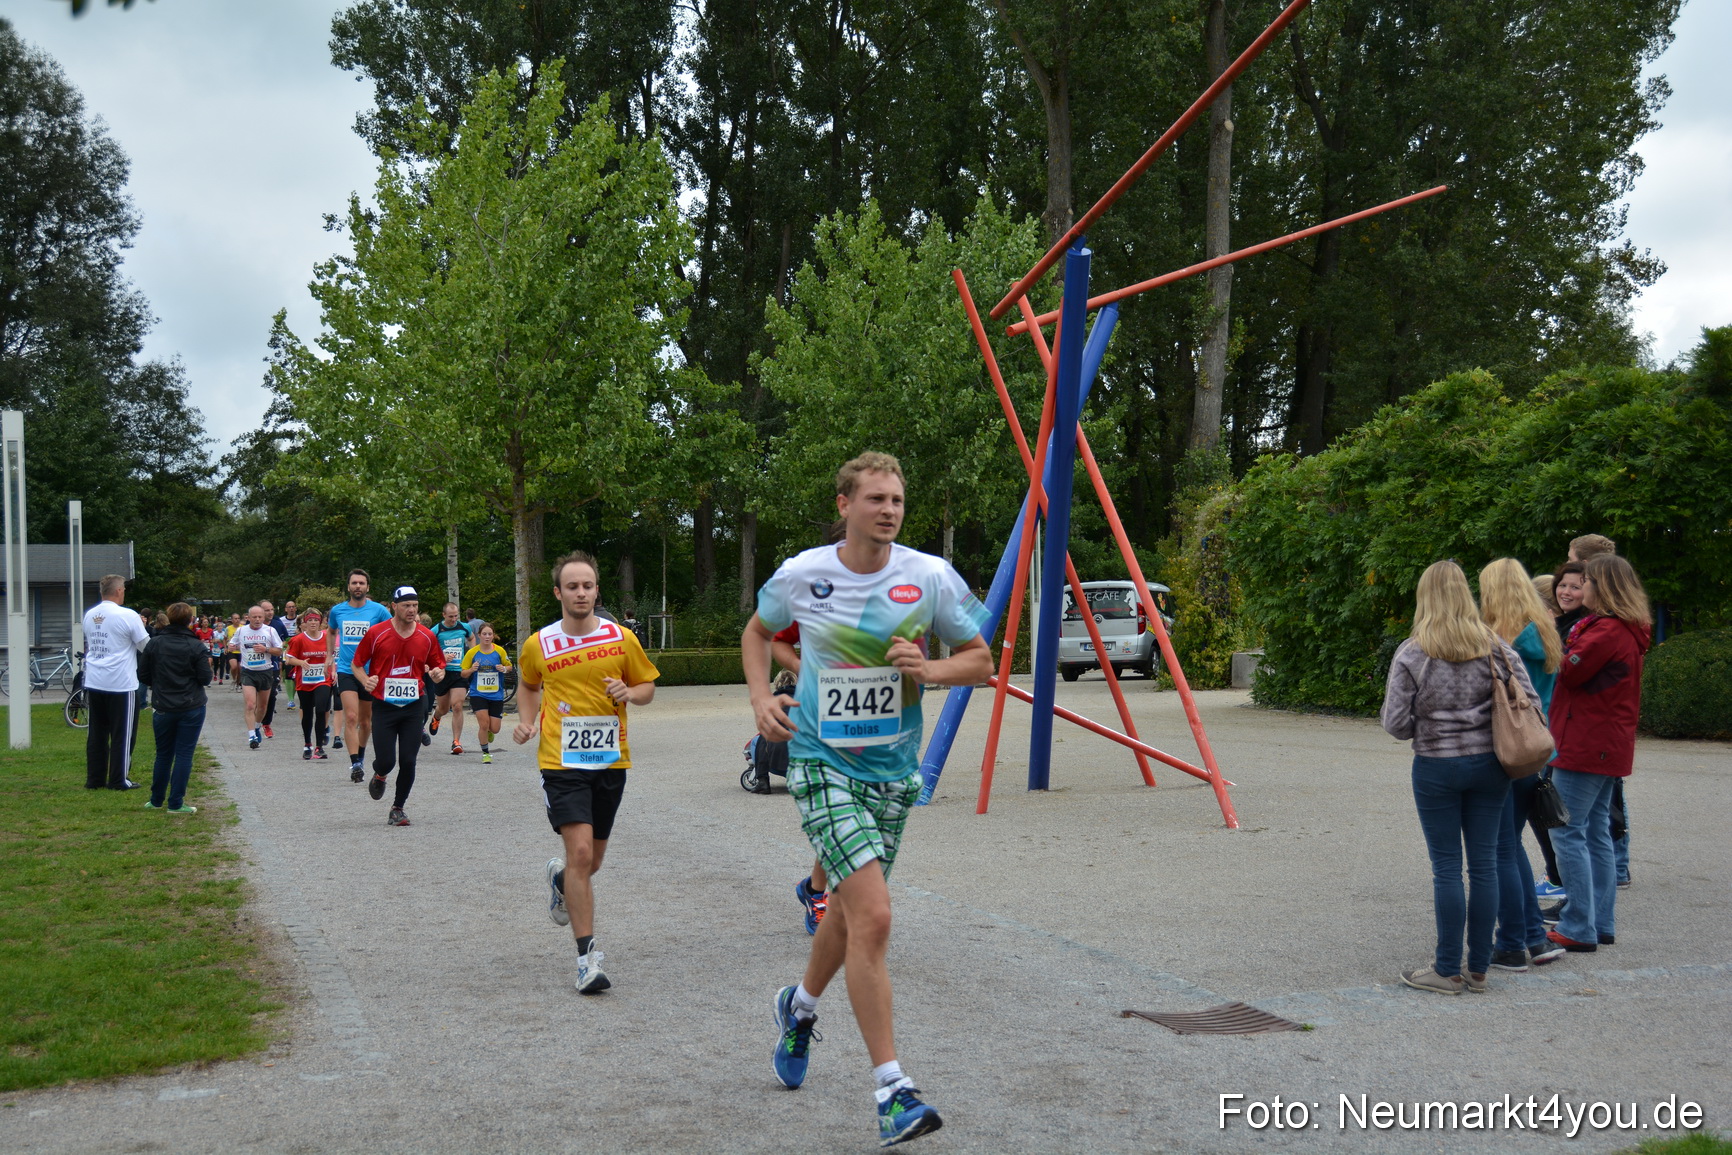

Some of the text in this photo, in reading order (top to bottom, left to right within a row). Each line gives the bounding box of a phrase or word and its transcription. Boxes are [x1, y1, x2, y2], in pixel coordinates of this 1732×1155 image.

[345, 626, 368, 636] 2276
[546, 645, 626, 673] MAX BÖGL
[304, 668, 323, 677] 2377
[482, 677, 496, 685] 102
[820, 675, 888, 684] PARTL Neumarkt
[388, 685, 416, 697] 2043
[827, 686, 894, 716] 2442
[843, 723, 879, 735] Tobias
[568, 729, 615, 749] 2824
[580, 753, 604, 762] Stefan
